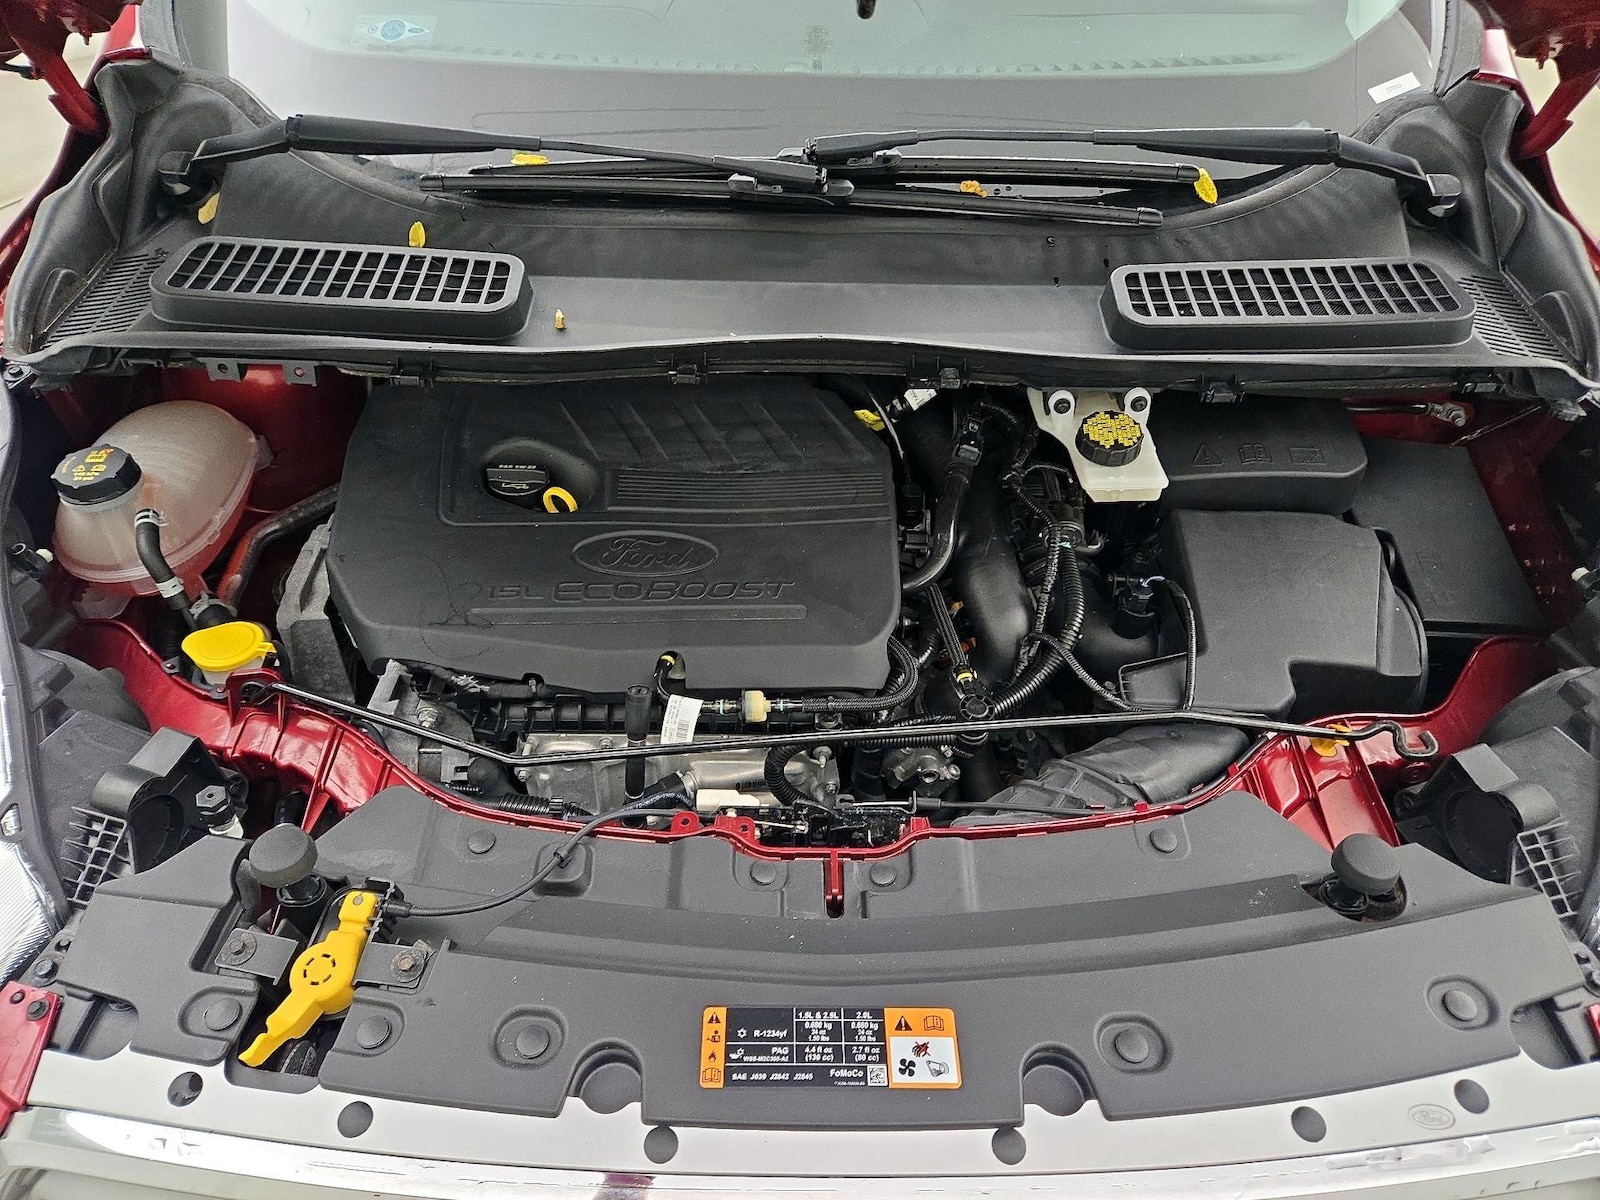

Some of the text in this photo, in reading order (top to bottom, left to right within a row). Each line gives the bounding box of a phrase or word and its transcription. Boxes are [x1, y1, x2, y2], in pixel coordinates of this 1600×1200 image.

[598, 537, 694, 569] Ford
[798, 1011, 839, 1019] 1.5L & 2.5L
[856, 1011, 872, 1019] 2.0L
[823, 1021, 833, 1031] kg
[869, 1022, 879, 1031] kg
[753, 1029, 788, 1039] R-1234yf
[771, 1046, 789, 1055] PAG
[804, 1046, 816, 1054] 4.4
[816, 1046, 824, 1054] fl
[851, 1046, 864, 1054] 2.7
[864, 1046, 870, 1054] fl
[805, 1054, 834, 1062] (130 cc)
[855, 1054, 880, 1062] (80 cc)
[731, 1073, 748, 1081] SAE
[829, 1069, 864, 1078] FoMoCo
